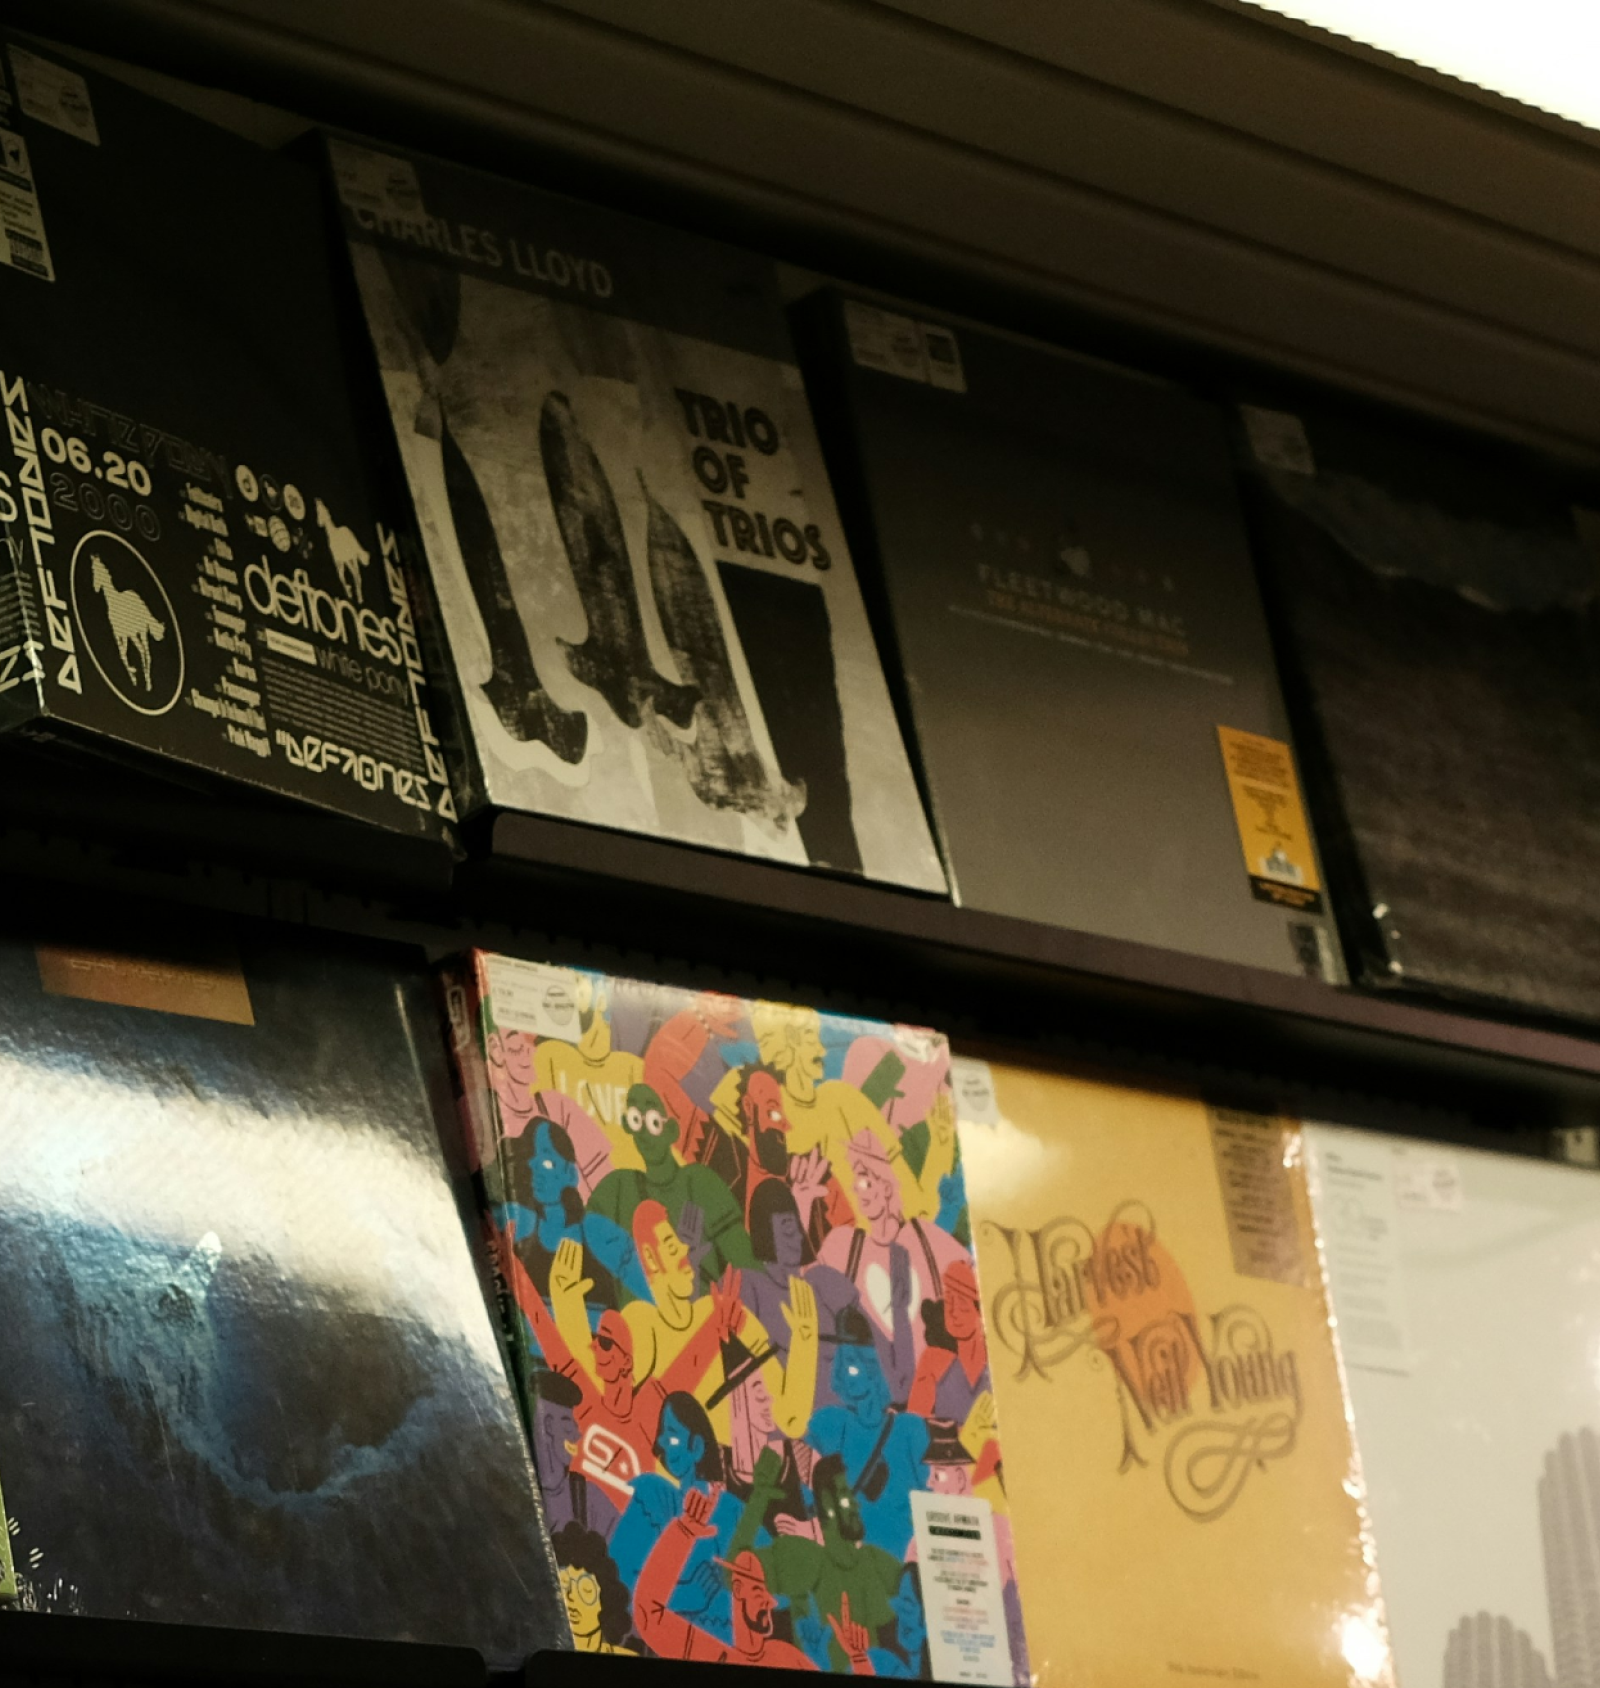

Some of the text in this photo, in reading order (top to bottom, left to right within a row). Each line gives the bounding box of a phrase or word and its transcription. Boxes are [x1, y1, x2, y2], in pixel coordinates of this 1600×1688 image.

[508, 238, 614, 299] LLOYD
[673, 386, 779, 456] TRIO
[40, 426, 152, 497] 06.20
[692, 446, 750, 499] OF
[701, 499, 831, 571] TRIOS
[244, 554, 403, 666] deftones
